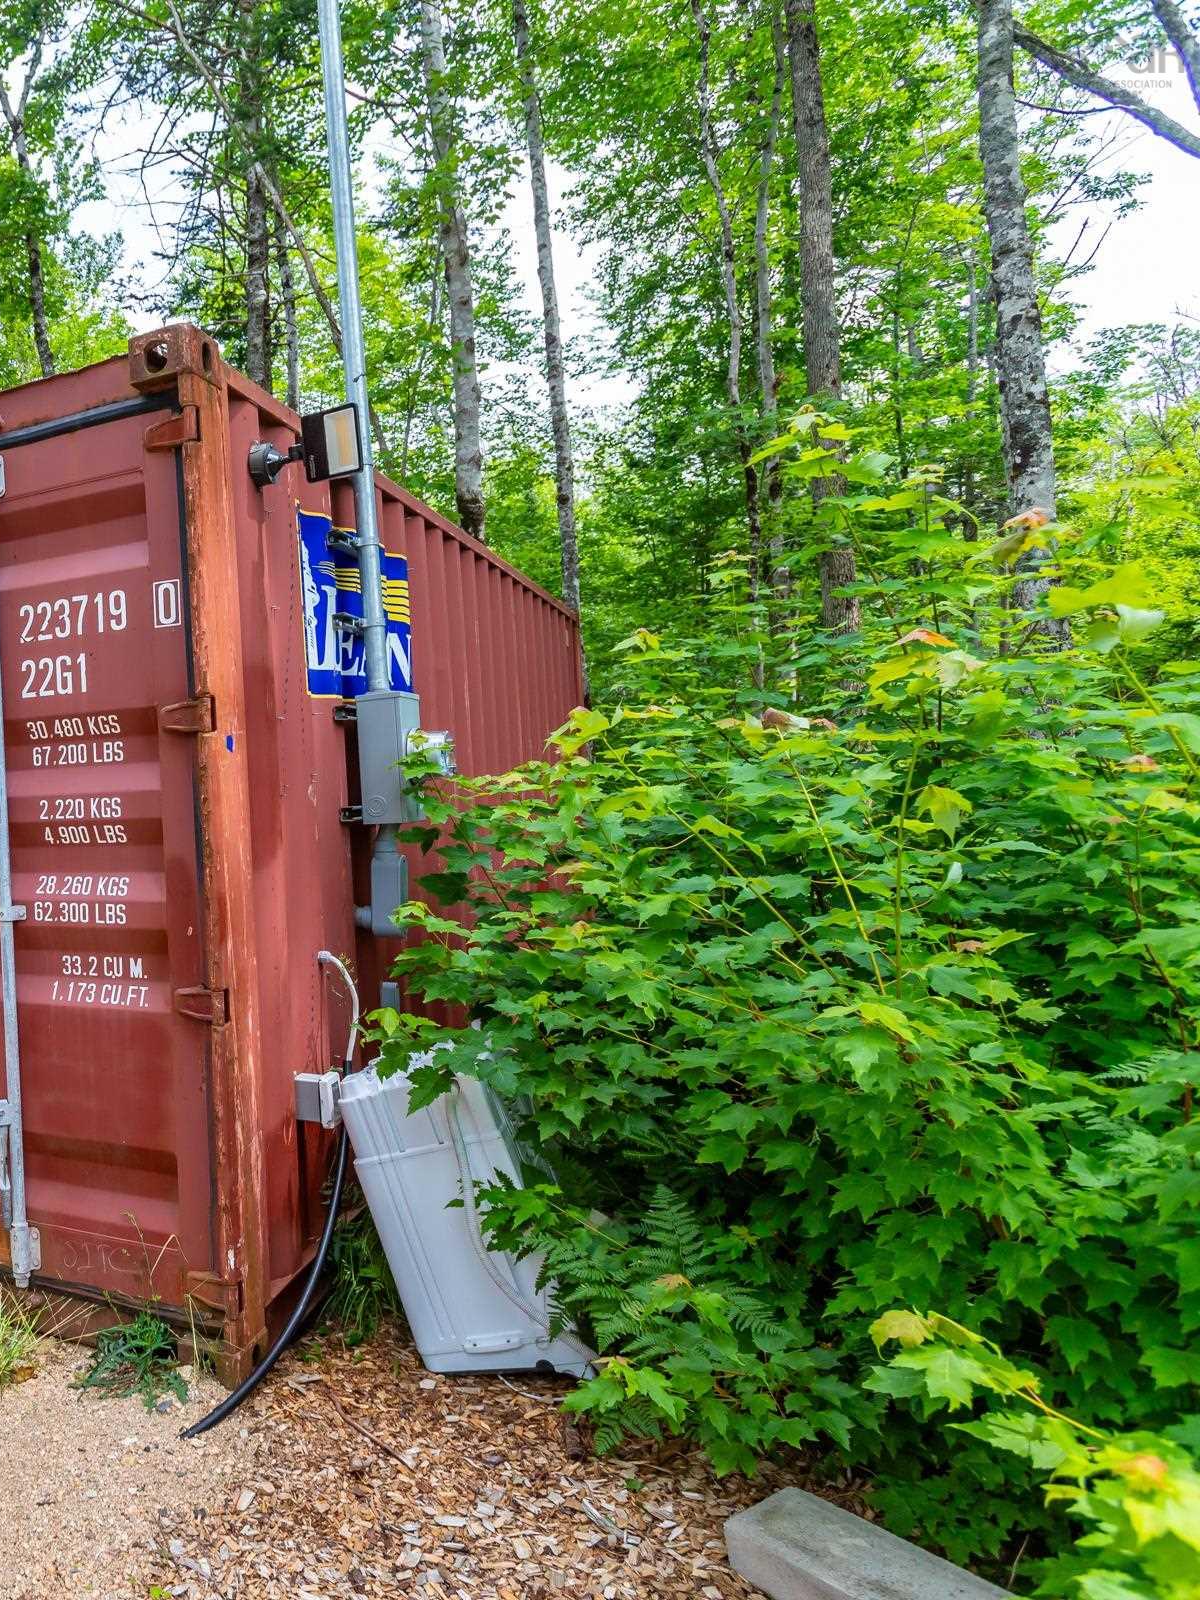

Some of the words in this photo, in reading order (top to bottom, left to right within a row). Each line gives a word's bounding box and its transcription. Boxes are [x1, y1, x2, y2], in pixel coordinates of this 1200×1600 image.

[19, 590, 127, 643] 223719
[158, 583, 176, 624] 0
[21, 653, 87, 698] 22G1
[87, 715, 120, 735] KGS
[93, 741, 123, 763] LBS
[90, 798, 121, 818] KGS
[93, 825, 127, 843] LBS
[97, 877, 129, 896] KGS
[95, 904, 126, 924] LBS
[62, 955, 98, 976] 33.2
[130, 958, 147, 978] M.
